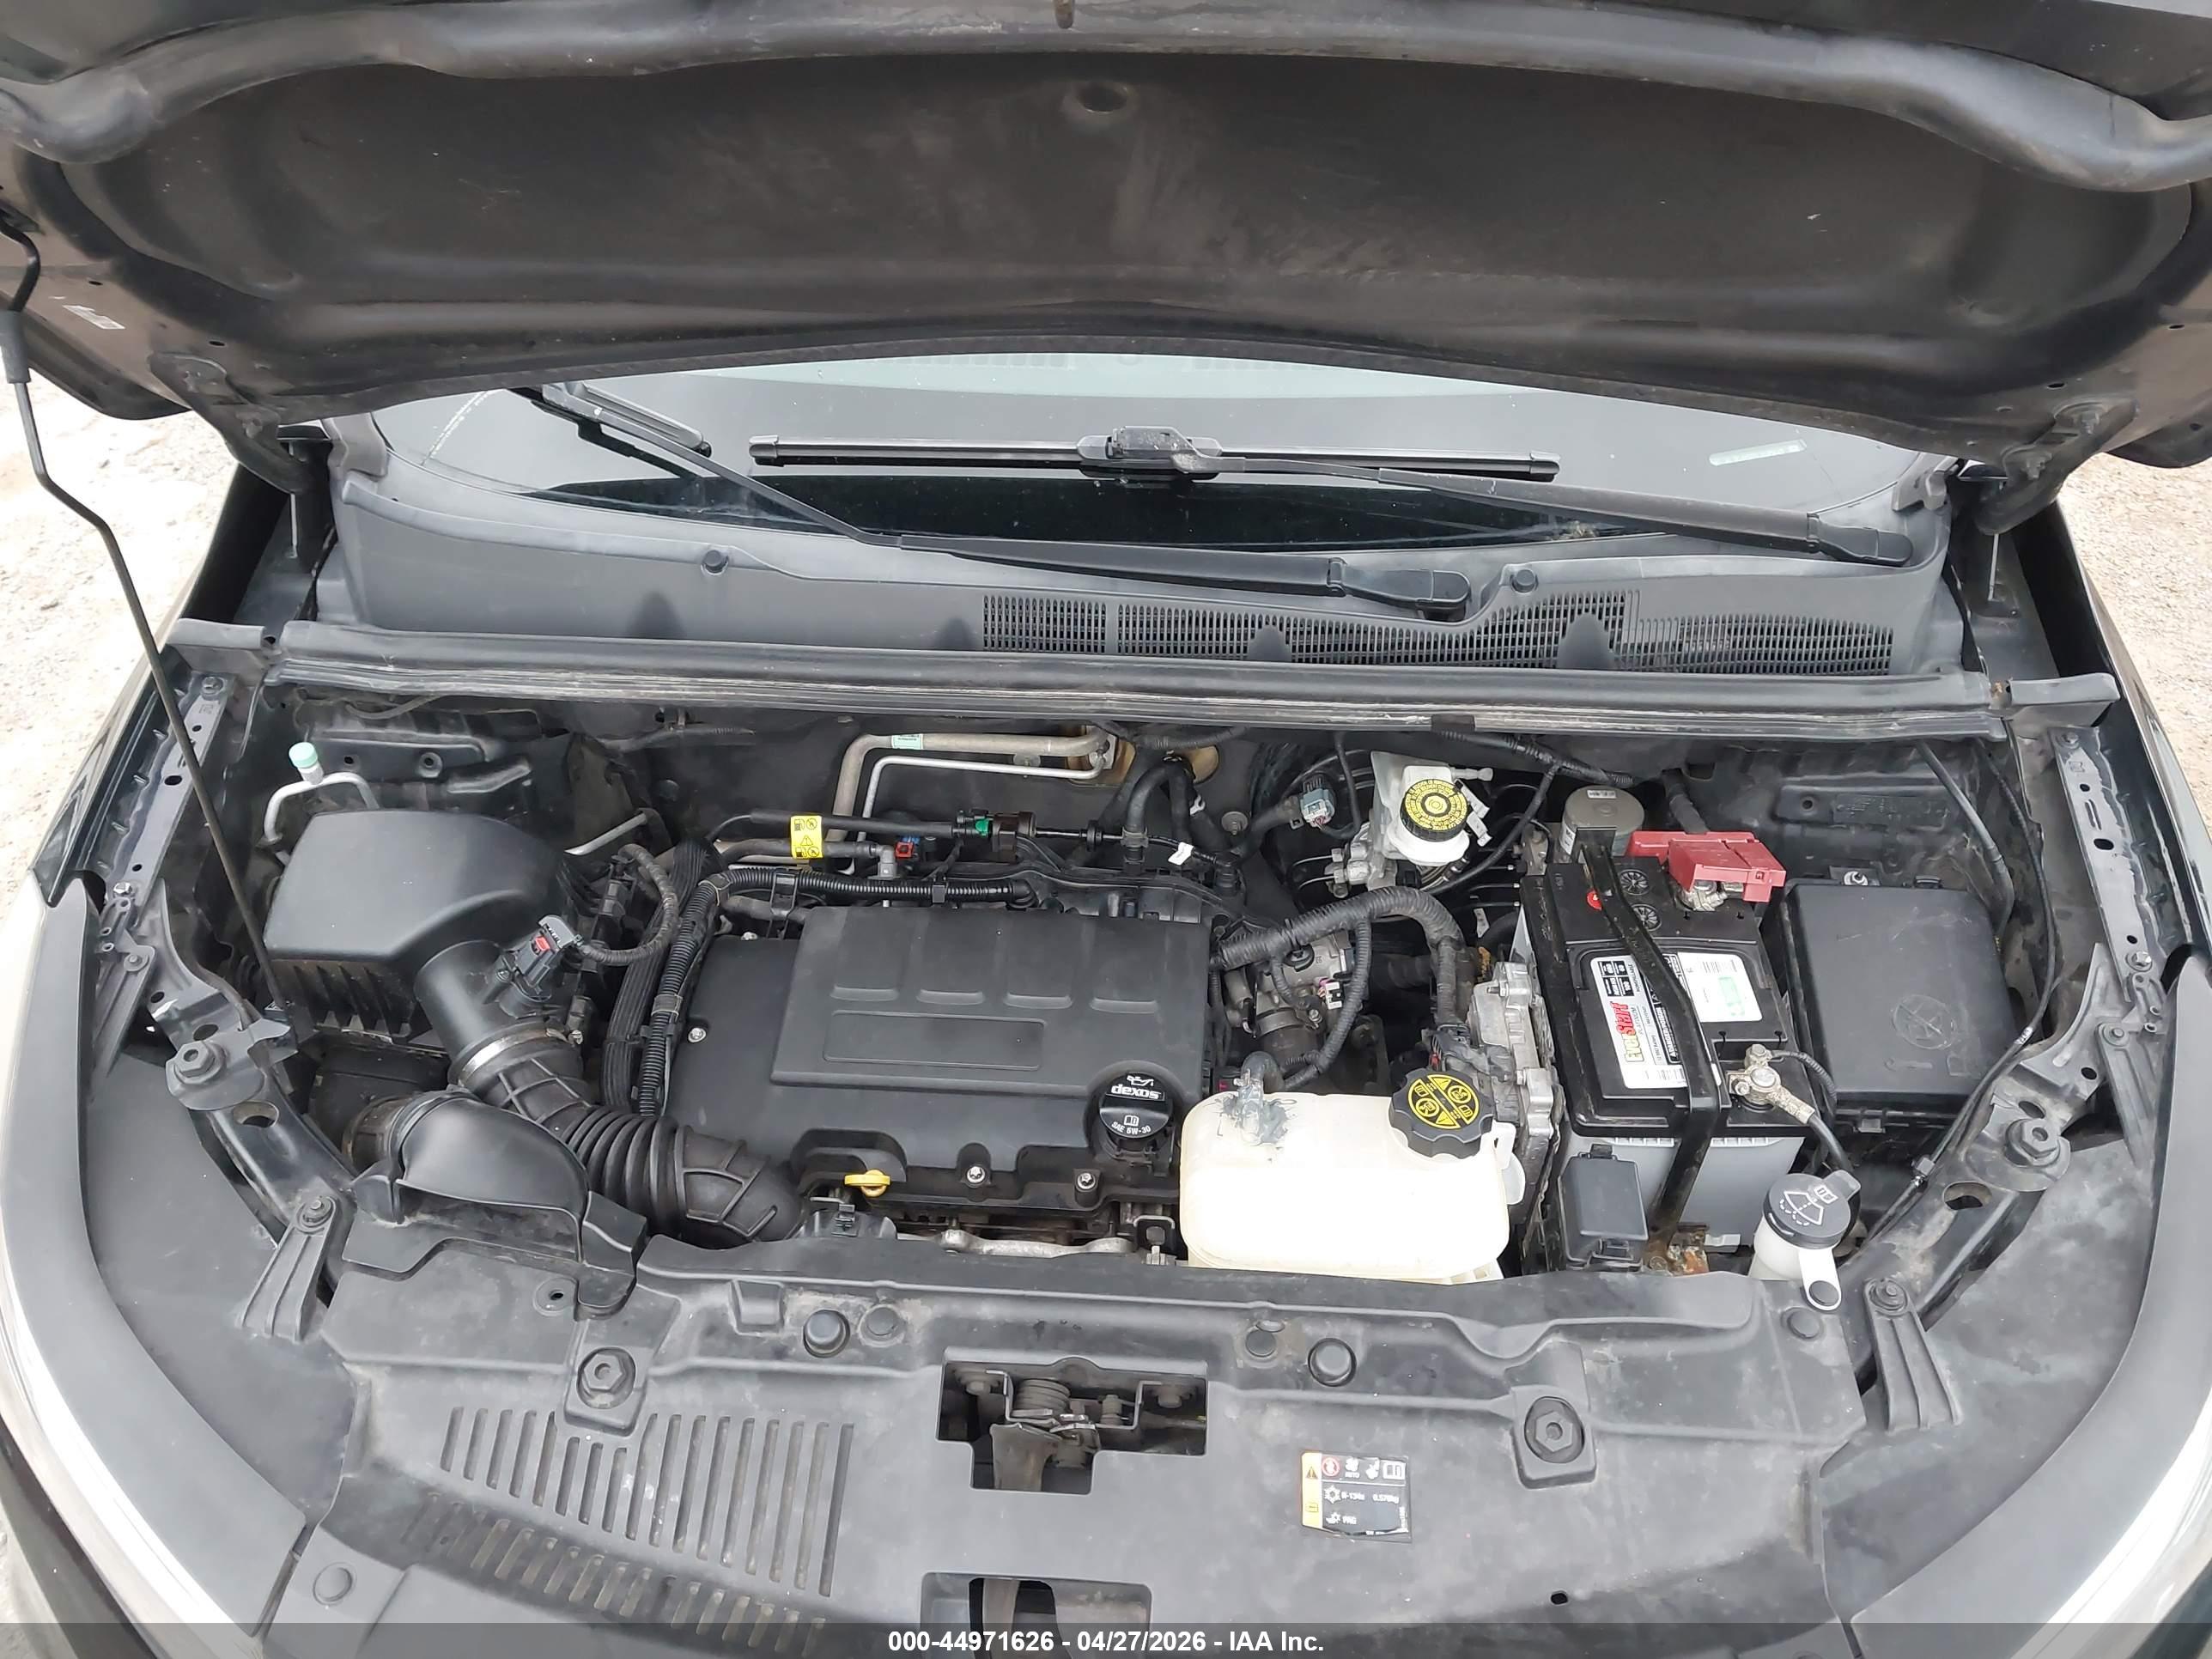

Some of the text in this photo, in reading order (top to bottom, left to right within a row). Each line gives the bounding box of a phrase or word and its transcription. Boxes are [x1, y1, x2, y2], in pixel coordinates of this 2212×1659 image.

[1610, 1002, 1644, 1062] EverStart
[1111, 1084, 1162, 1099] dexos
[1111, 1121, 1126, 1133] SAE
